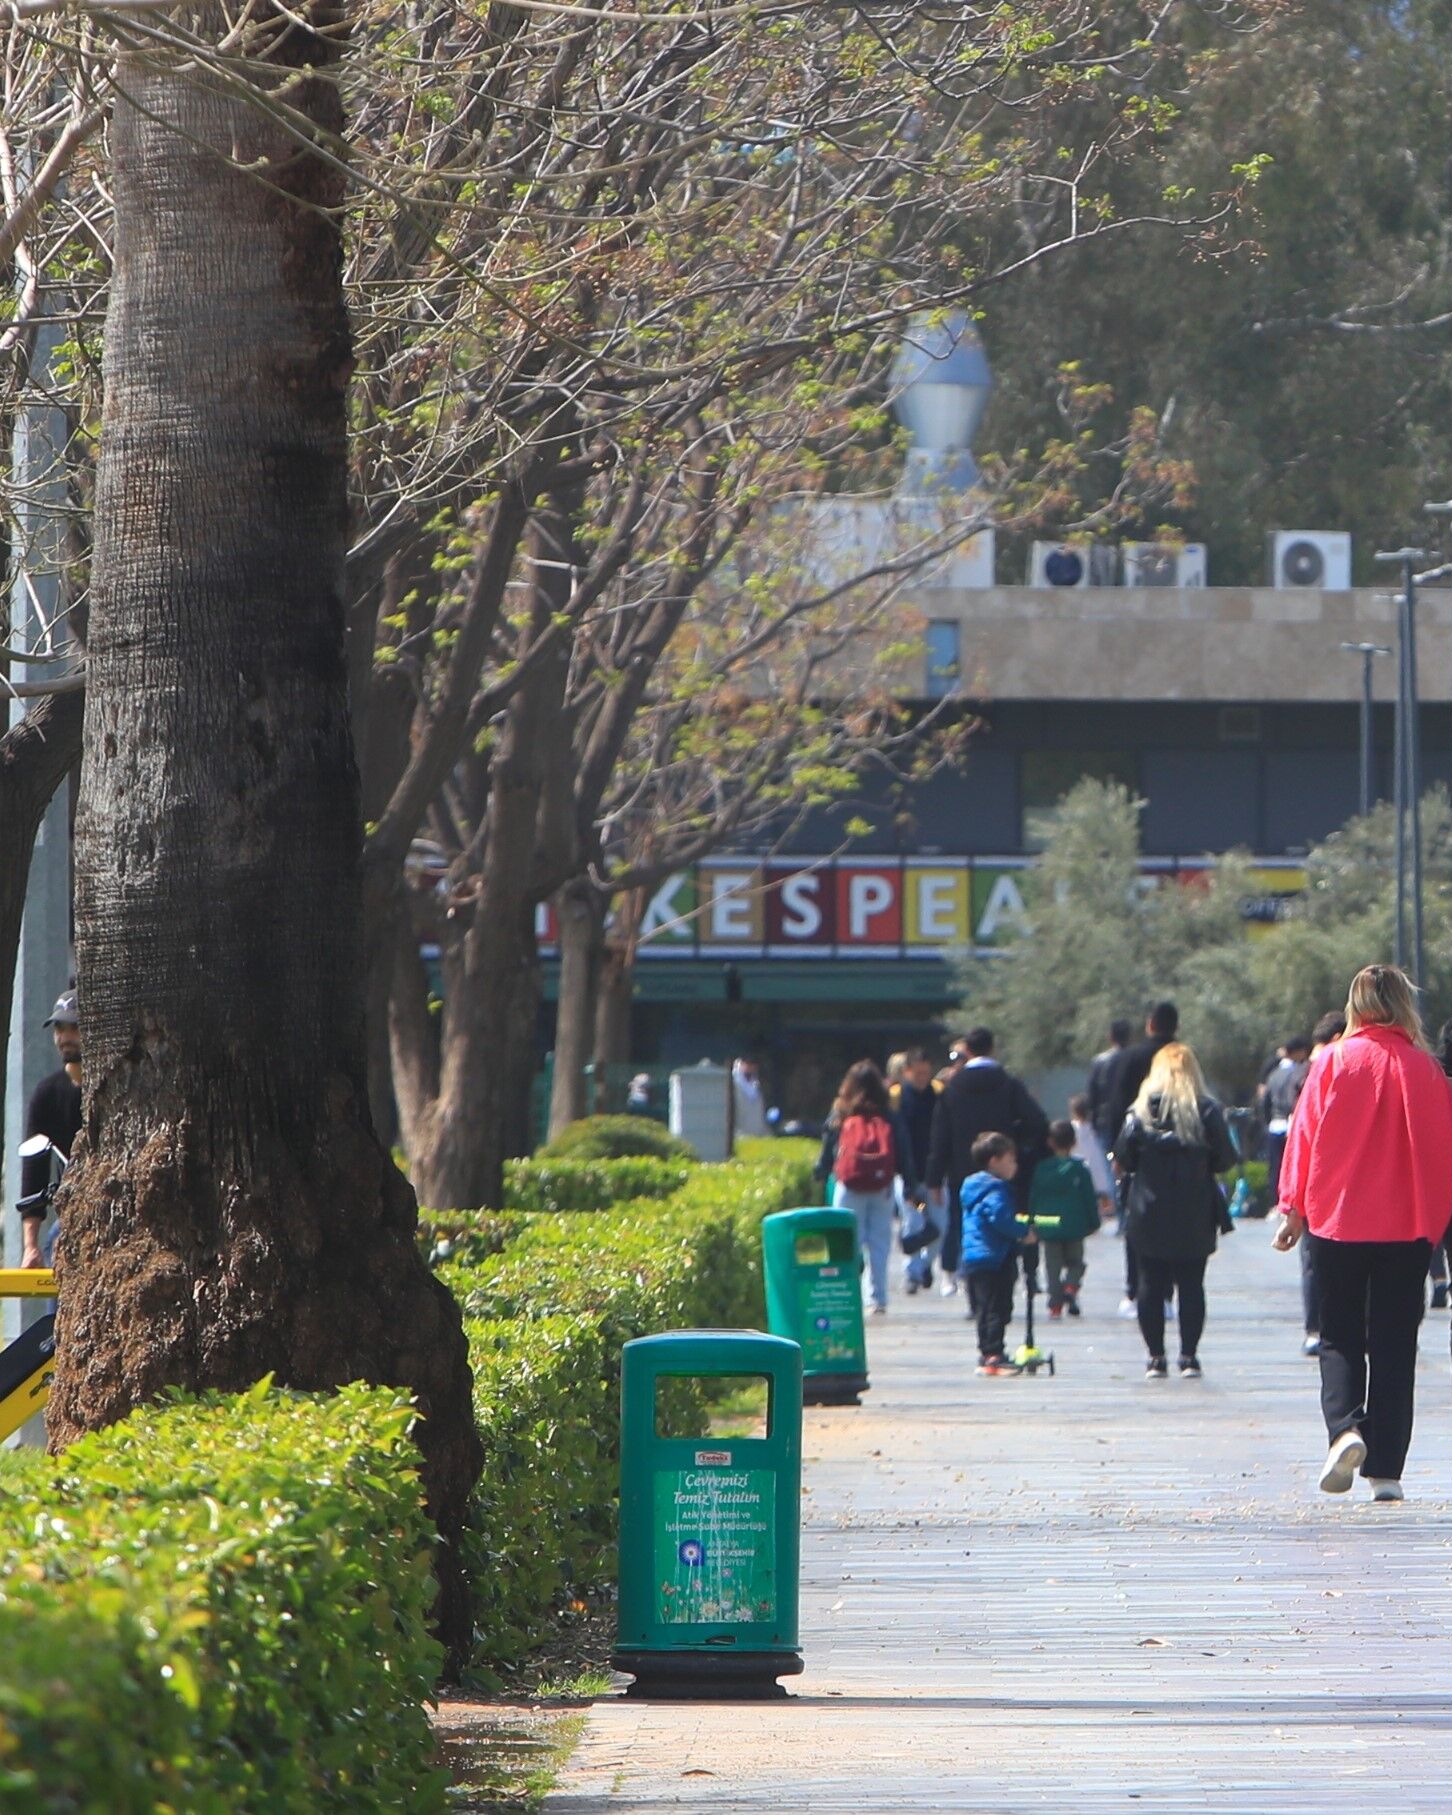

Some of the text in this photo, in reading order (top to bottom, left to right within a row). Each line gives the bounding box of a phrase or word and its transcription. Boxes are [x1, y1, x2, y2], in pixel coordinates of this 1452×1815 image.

[685, 1474, 748, 1489] Çevremizi
[674, 1491, 760, 1505] Temiz Tutalım
